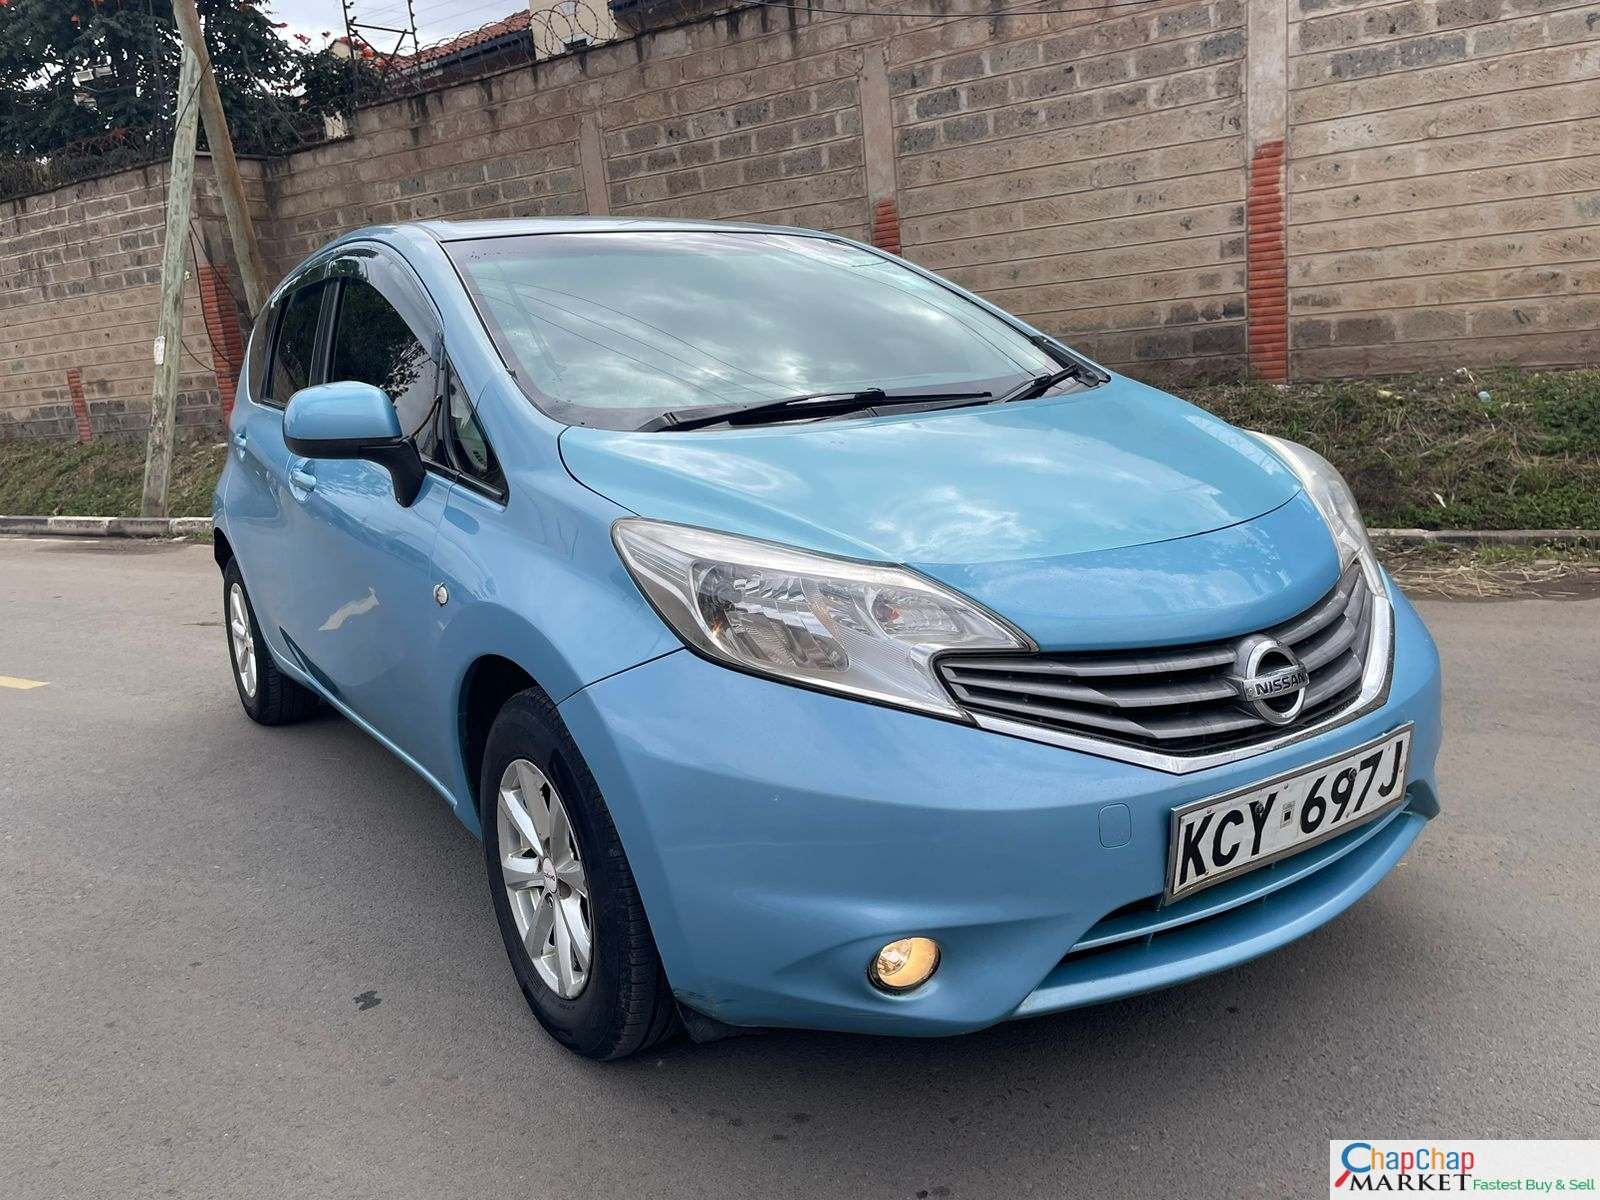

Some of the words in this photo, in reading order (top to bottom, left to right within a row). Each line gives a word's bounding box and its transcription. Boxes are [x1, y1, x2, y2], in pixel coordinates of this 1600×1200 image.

[1255, 672, 1307, 696] NISSAN
[1179, 792, 1278, 886] KCY
[1300, 741, 1403, 834] 697J
